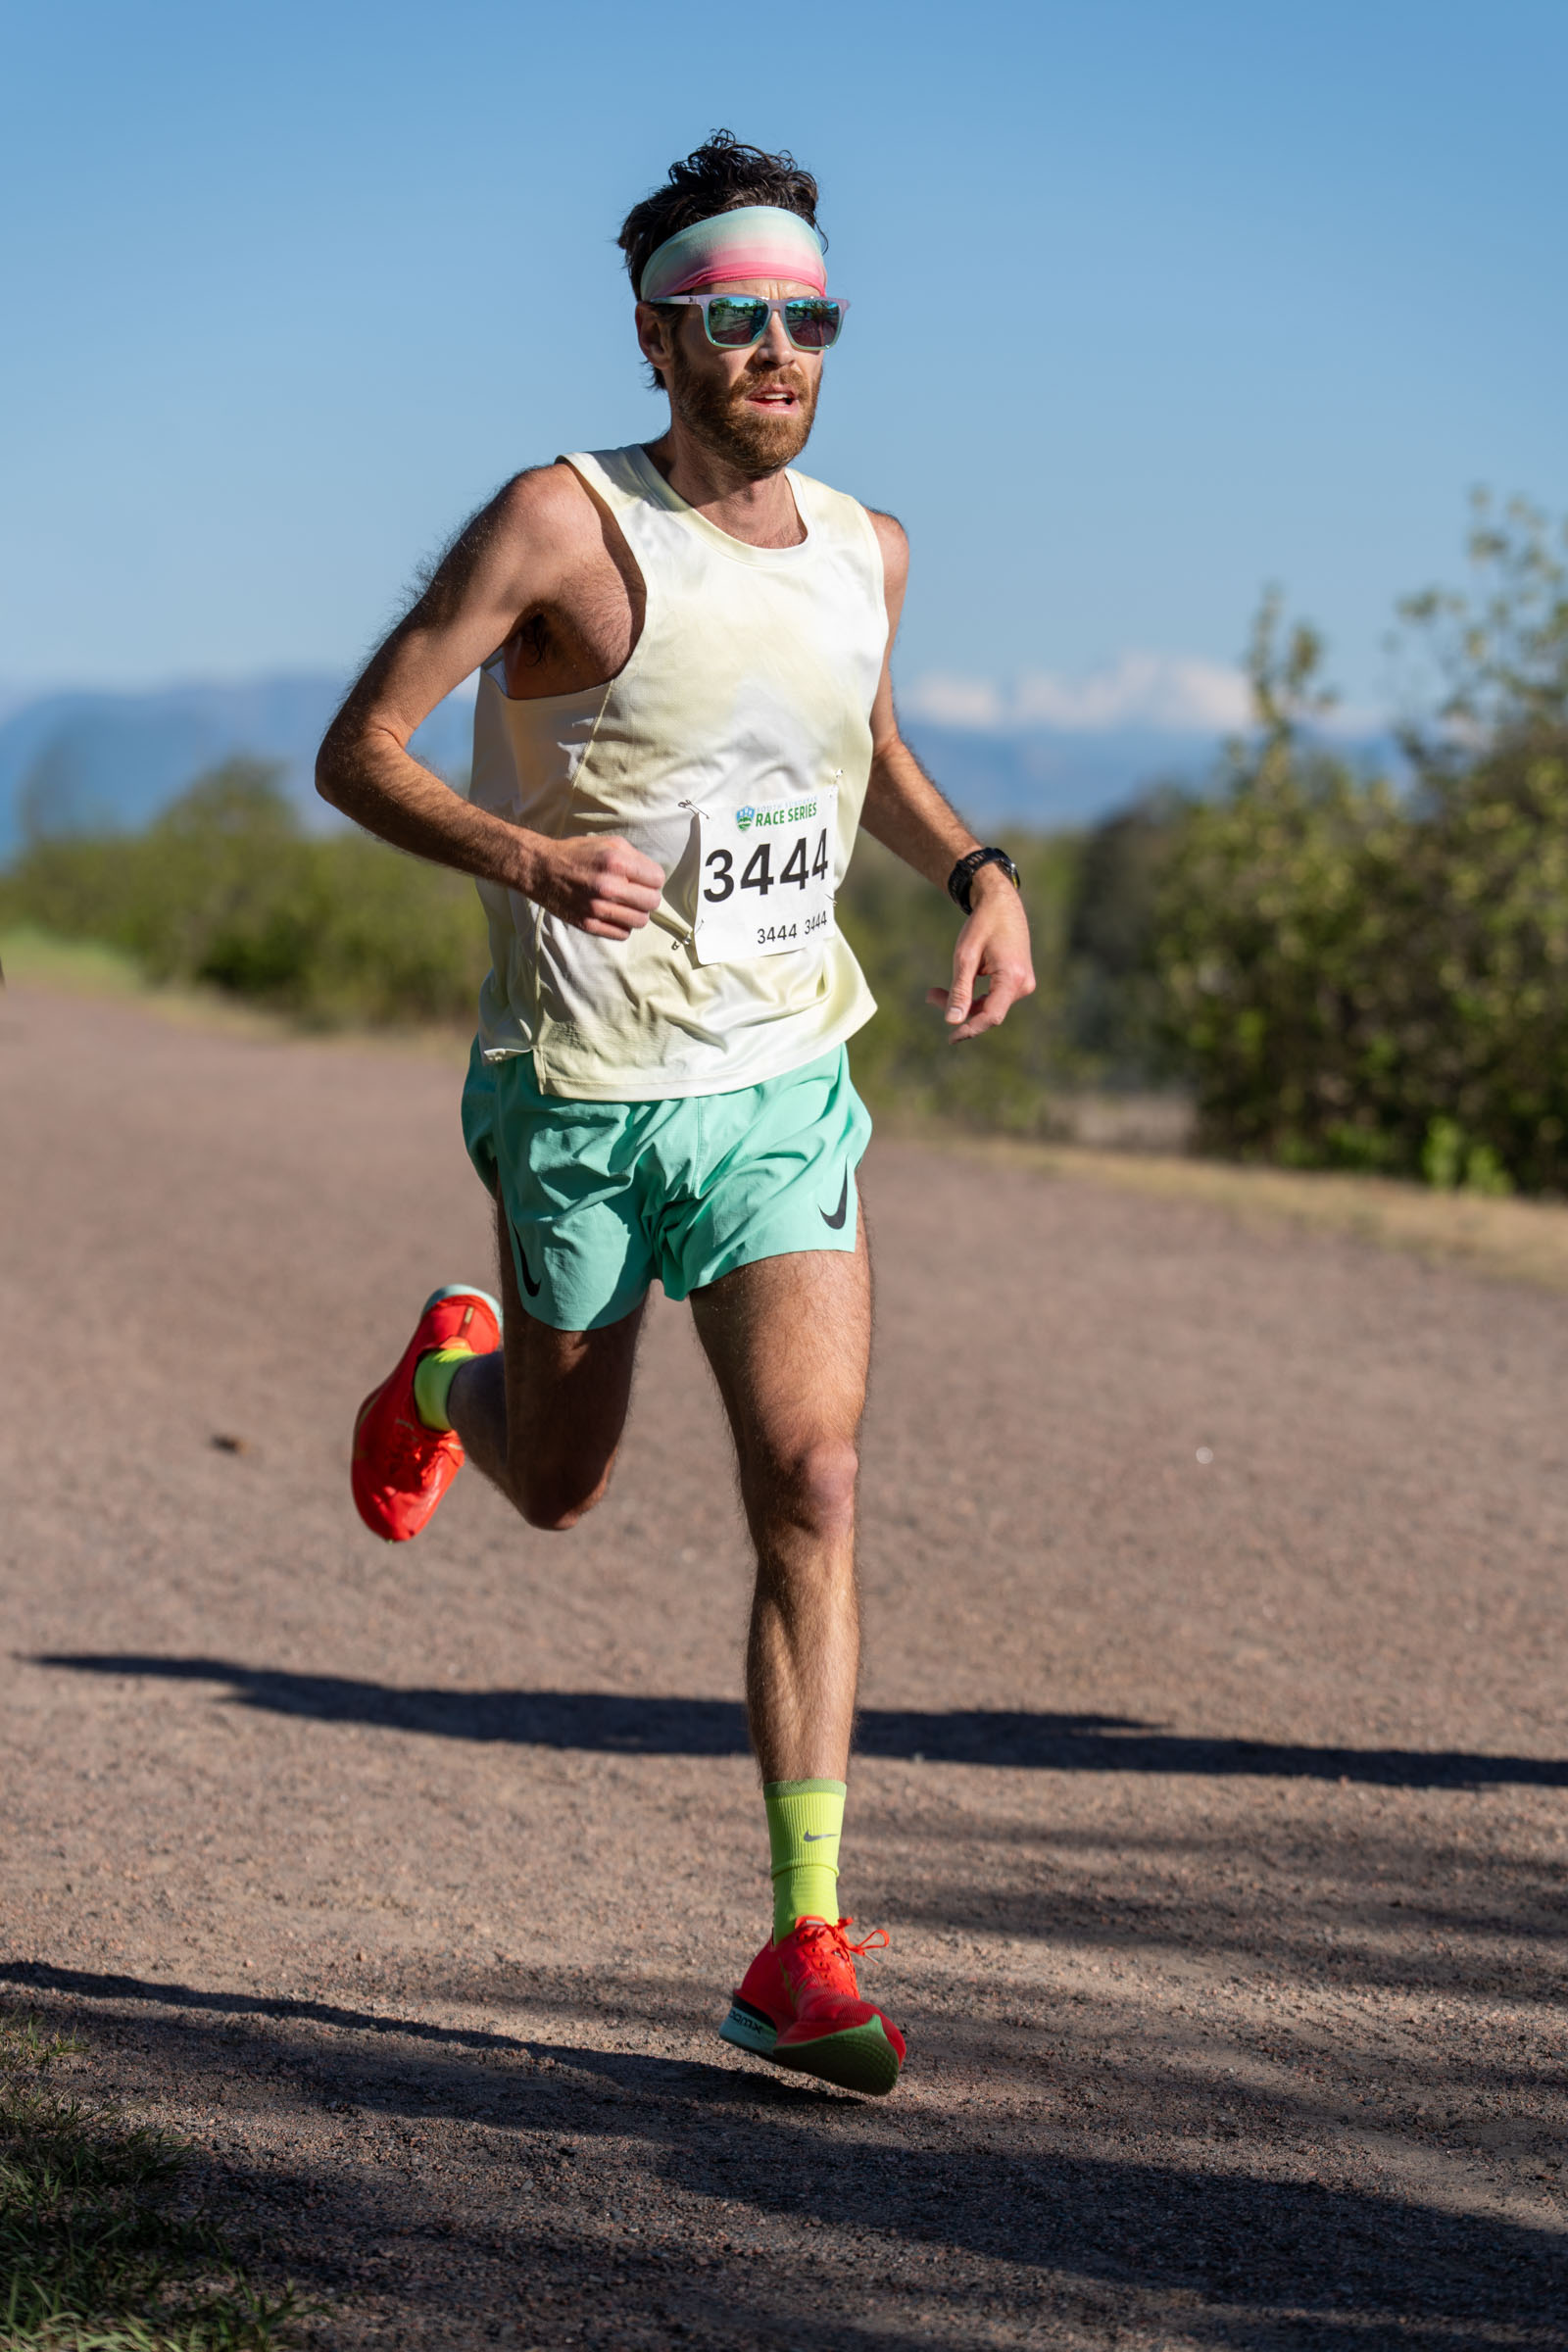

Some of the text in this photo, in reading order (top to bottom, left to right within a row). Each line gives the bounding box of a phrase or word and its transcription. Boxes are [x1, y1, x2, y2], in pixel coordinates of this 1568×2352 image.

[756, 802, 817, 827] RACE SERIES
[704, 828, 828, 903] 3444
[757, 910, 827, 944] 3444 3444
